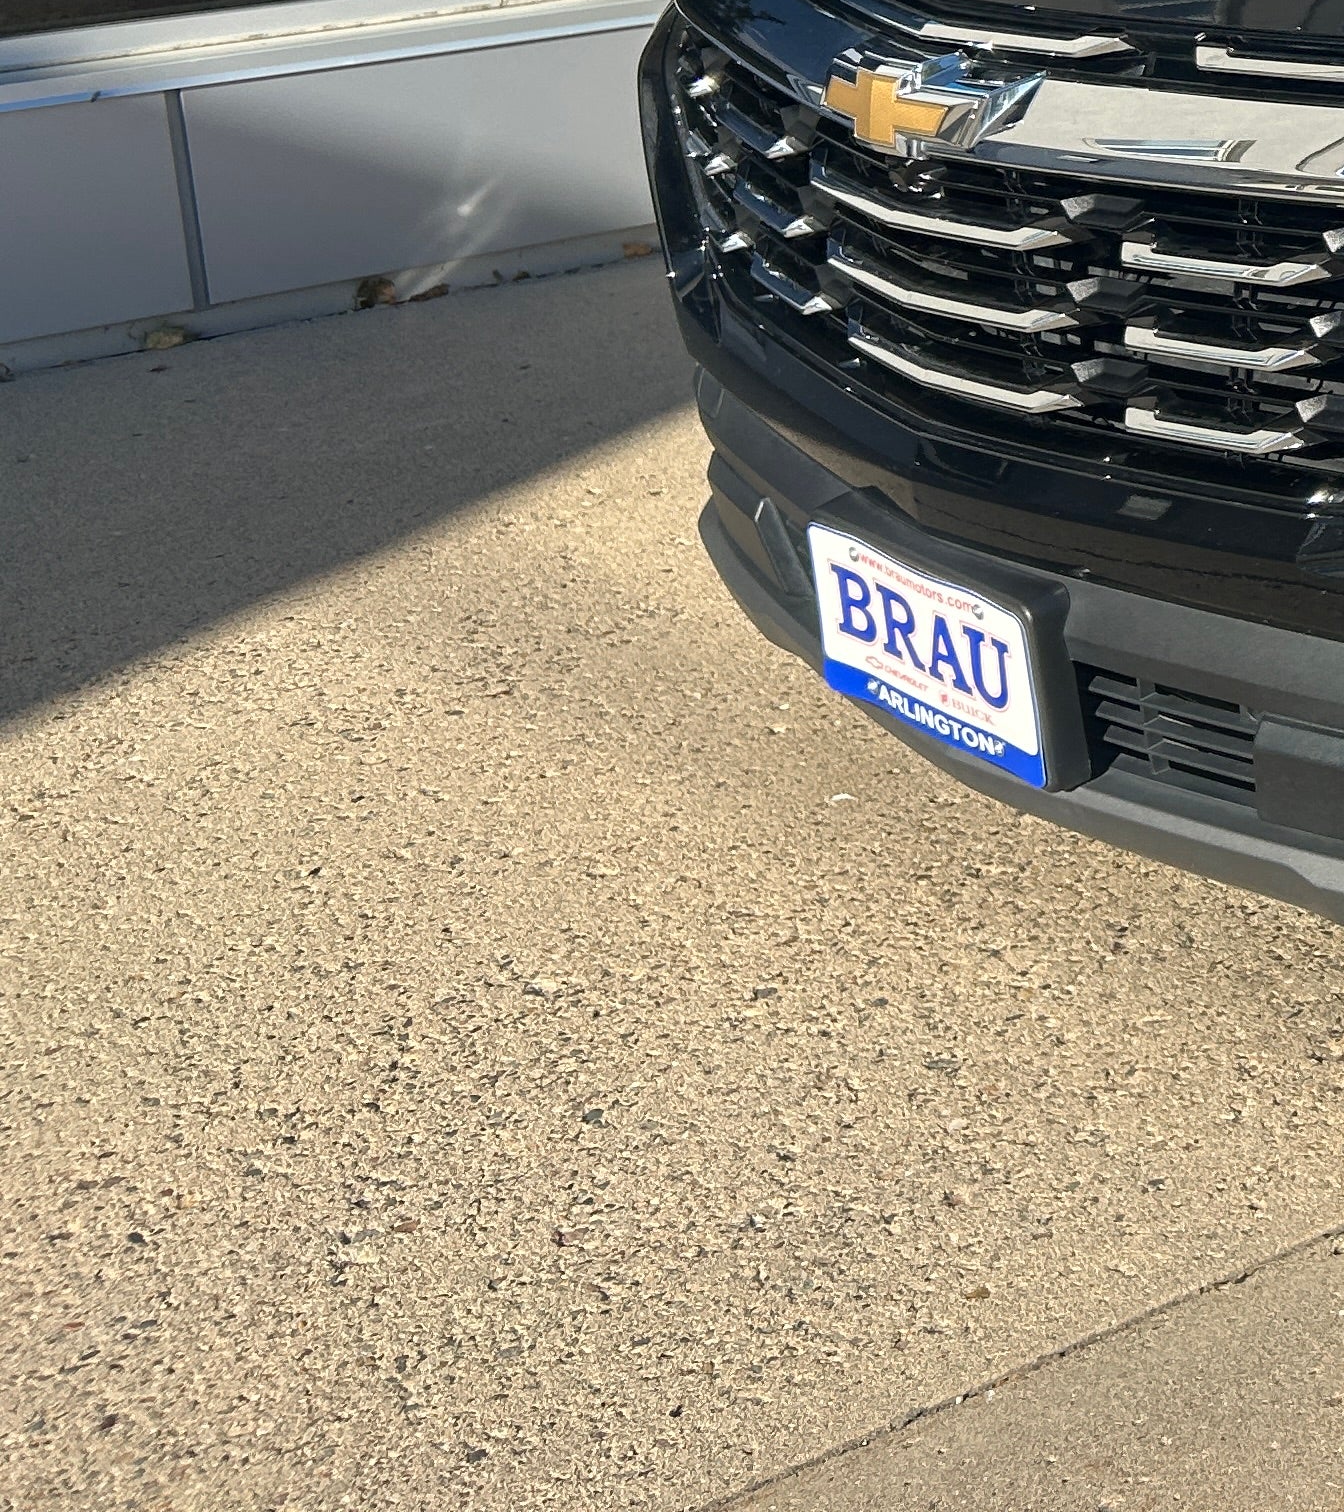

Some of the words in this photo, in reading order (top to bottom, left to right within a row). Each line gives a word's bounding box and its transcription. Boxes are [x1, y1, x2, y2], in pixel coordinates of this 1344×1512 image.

[857, 552, 975, 611] www.braumotors.com
[830, 561, 1009, 710] BRAU
[878, 684, 996, 756] ARLINGTON
[951, 697, 995, 727] BUICK
